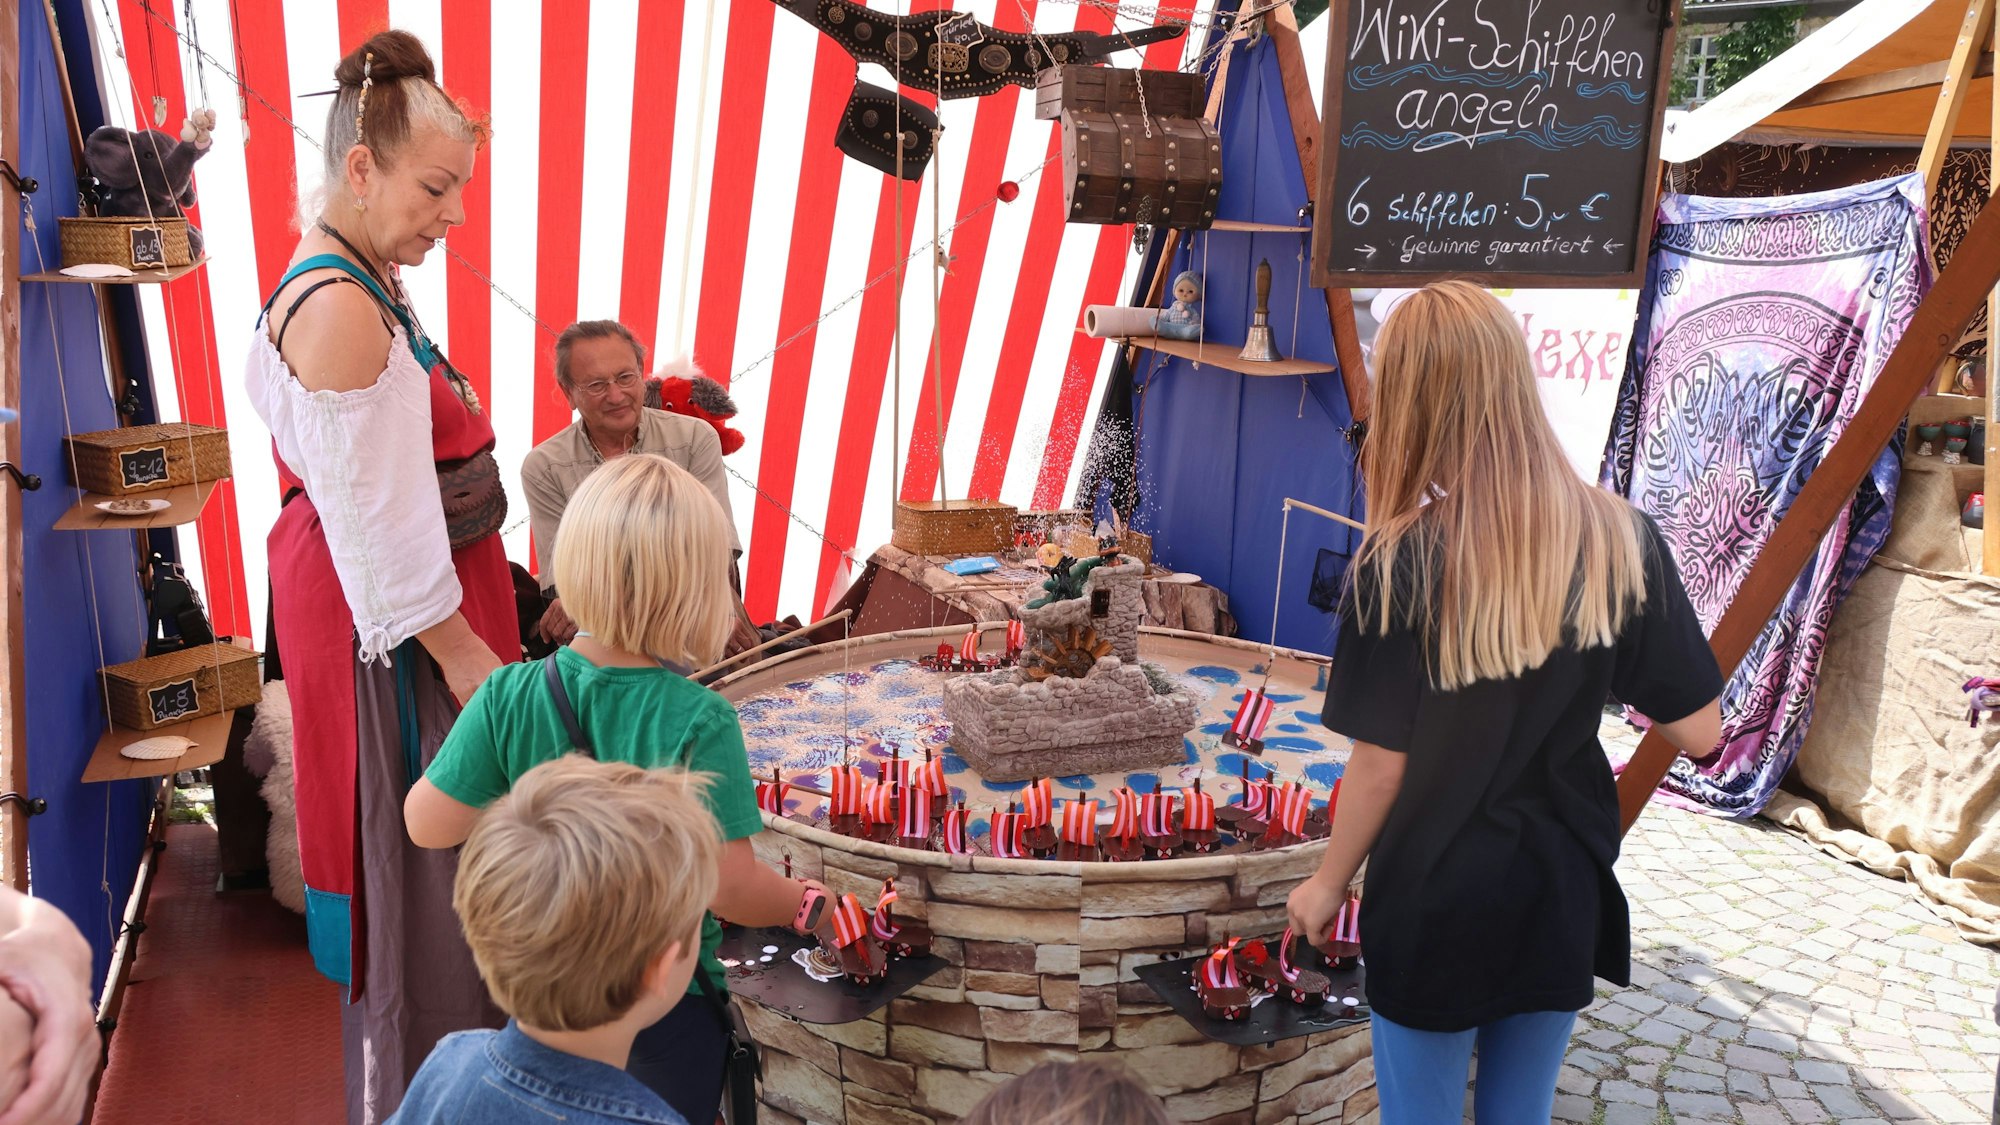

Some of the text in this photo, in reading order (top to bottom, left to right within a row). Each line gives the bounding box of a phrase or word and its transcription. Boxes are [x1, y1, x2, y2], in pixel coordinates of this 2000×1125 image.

[1395, 84, 1558, 152] angeln
[1347, 177, 1370, 226] 6
[1580, 193, 1609, 221] €
[136, 239, 147, 254] ab
[1399, 234, 1594, 265] Gewinne garantiert
